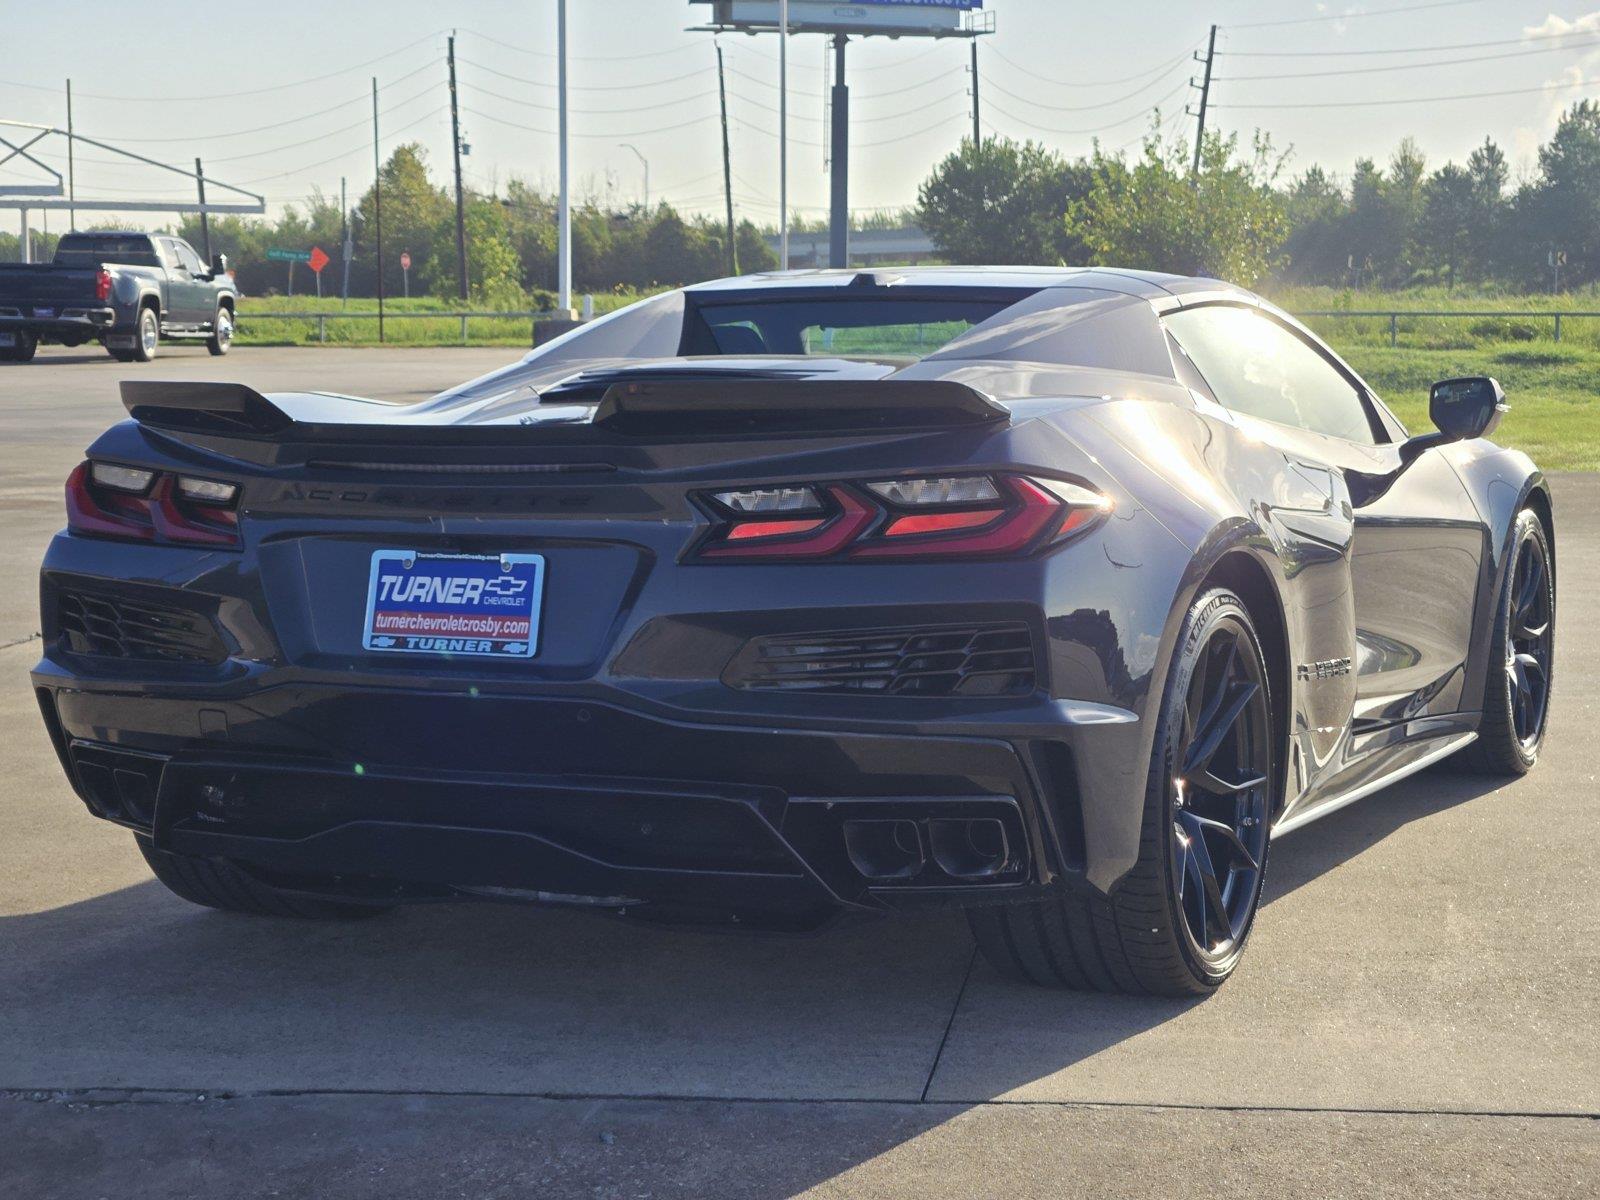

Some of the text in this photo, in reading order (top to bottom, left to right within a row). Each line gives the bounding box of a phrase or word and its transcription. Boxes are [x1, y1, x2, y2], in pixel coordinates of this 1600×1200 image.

[379, 575, 485, 605] TURNER
[484, 597, 525, 606] CHEVROLET
[376, 613, 529, 636] turnerchevroletcrosby.com
[406, 638, 492, 652] TURNER
